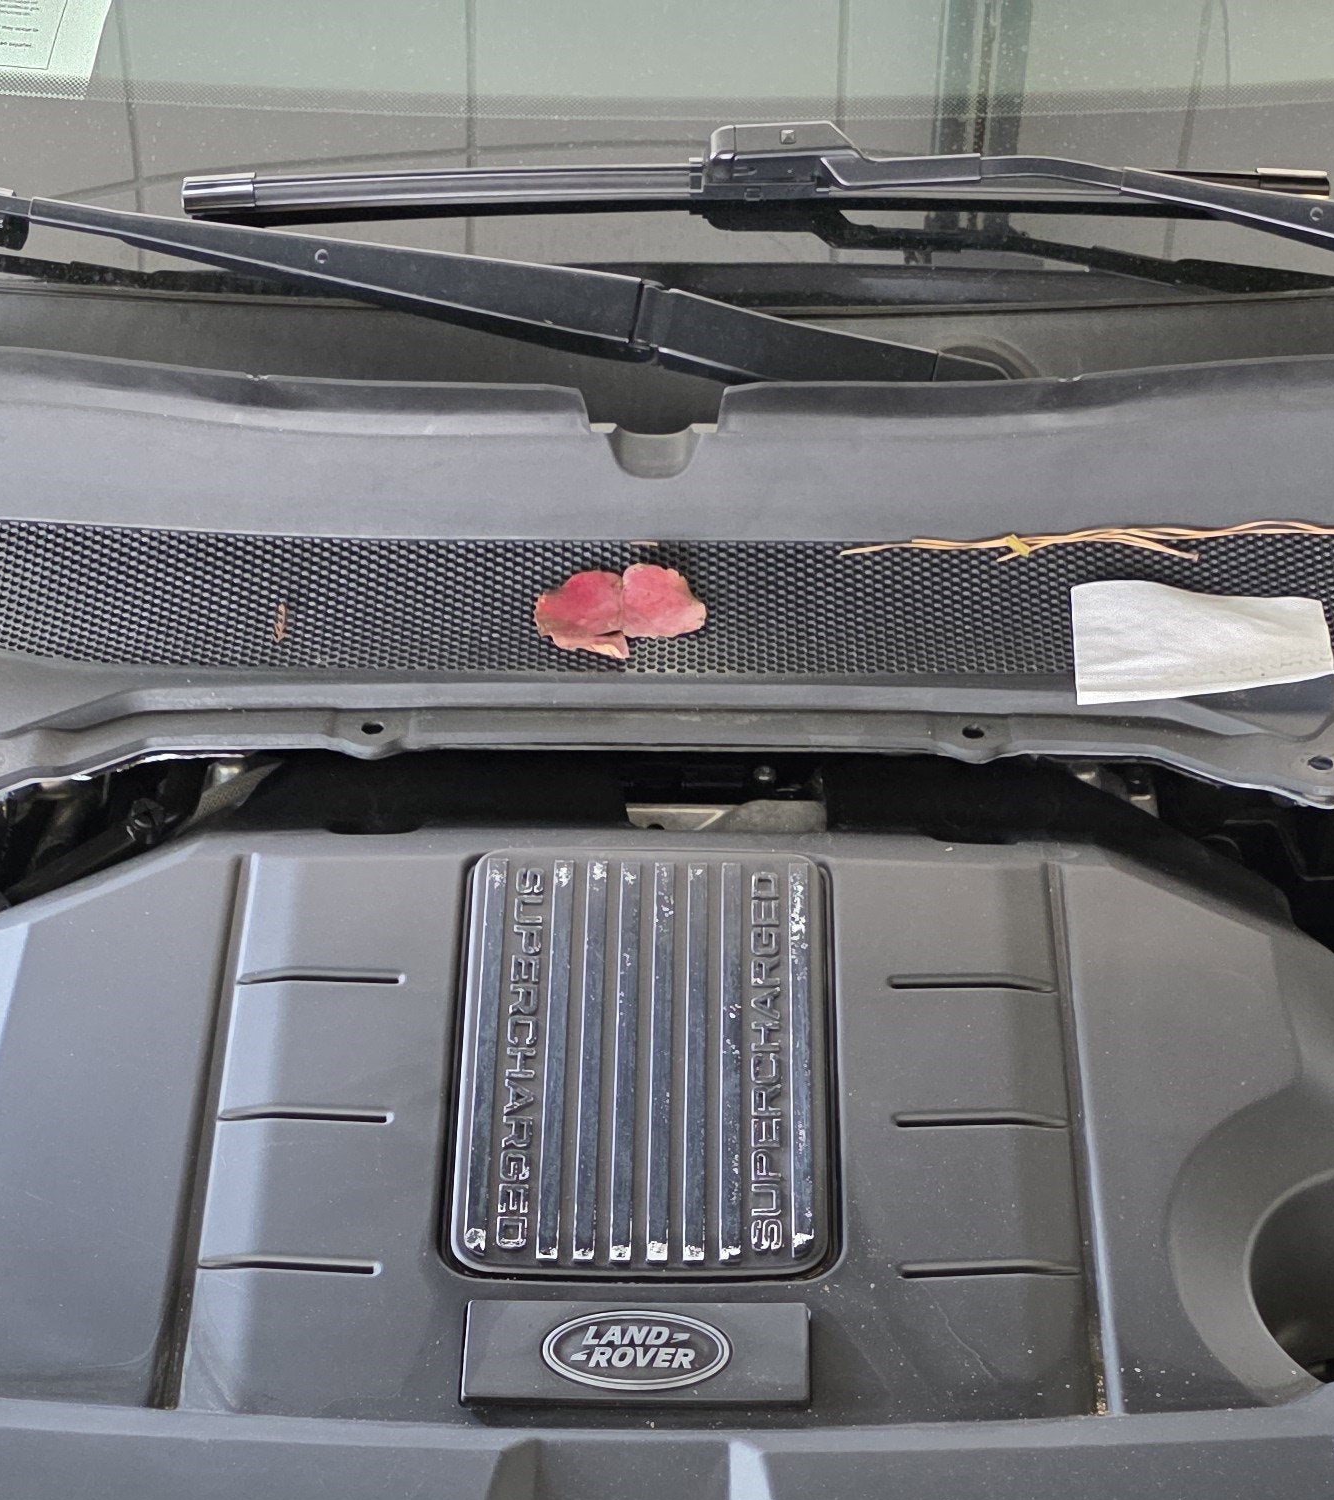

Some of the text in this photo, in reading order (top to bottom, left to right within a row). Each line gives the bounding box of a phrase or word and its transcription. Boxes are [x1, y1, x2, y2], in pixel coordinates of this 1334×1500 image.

[495, 866, 545, 1251] SUPERCHARGED
[750, 871, 784, 1252] SUPERCHARGED
[582, 1325, 670, 1345] LAND
[588, 1346, 696, 1369] ROVER
